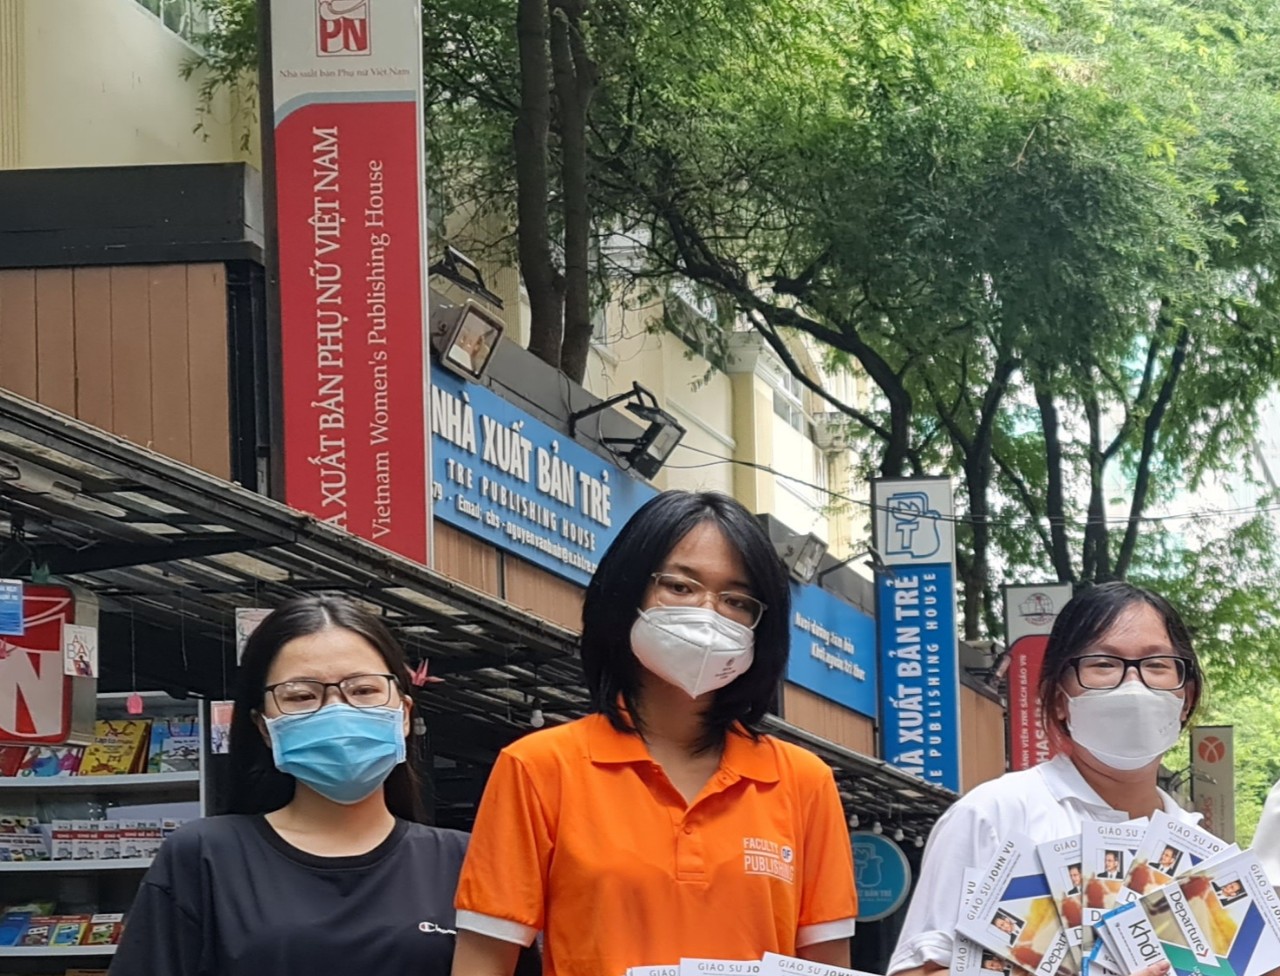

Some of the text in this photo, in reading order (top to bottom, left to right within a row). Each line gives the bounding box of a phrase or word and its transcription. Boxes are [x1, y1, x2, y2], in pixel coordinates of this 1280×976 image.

[313, 126, 339, 192] NAM
[307, 197, 346, 256] VIỆT
[308, 260, 342, 305] NỮ
[316, 309, 349, 368] PHỤ
[364, 159, 391, 539] Vietnam Women's Publishing House
[311, 373, 345, 430] BẢN
[307, 434, 348, 507] XUẤT
[431, 384, 612, 528] NHÀ XUẤT BẢN TRẺ
[481, 475, 558, 532] PUBLISHING
[561, 518, 597, 551] HOUSE
[886, 575, 920, 621] TRẺ
[923, 572, 938, 630] HOUSE
[888, 627, 923, 683] BẢN
[888, 684, 924, 744] XUẤT
[927, 643, 943, 758] PUBLISHING
[743, 836, 780, 854] FACULTY
[743, 855, 795, 882] PUBLISHING
[989, 856, 1006, 882] JOHN
[1002, 840, 1015, 855] VU
[1168, 890, 1206, 953] Departure
[746, 965, 760, 974] JO
